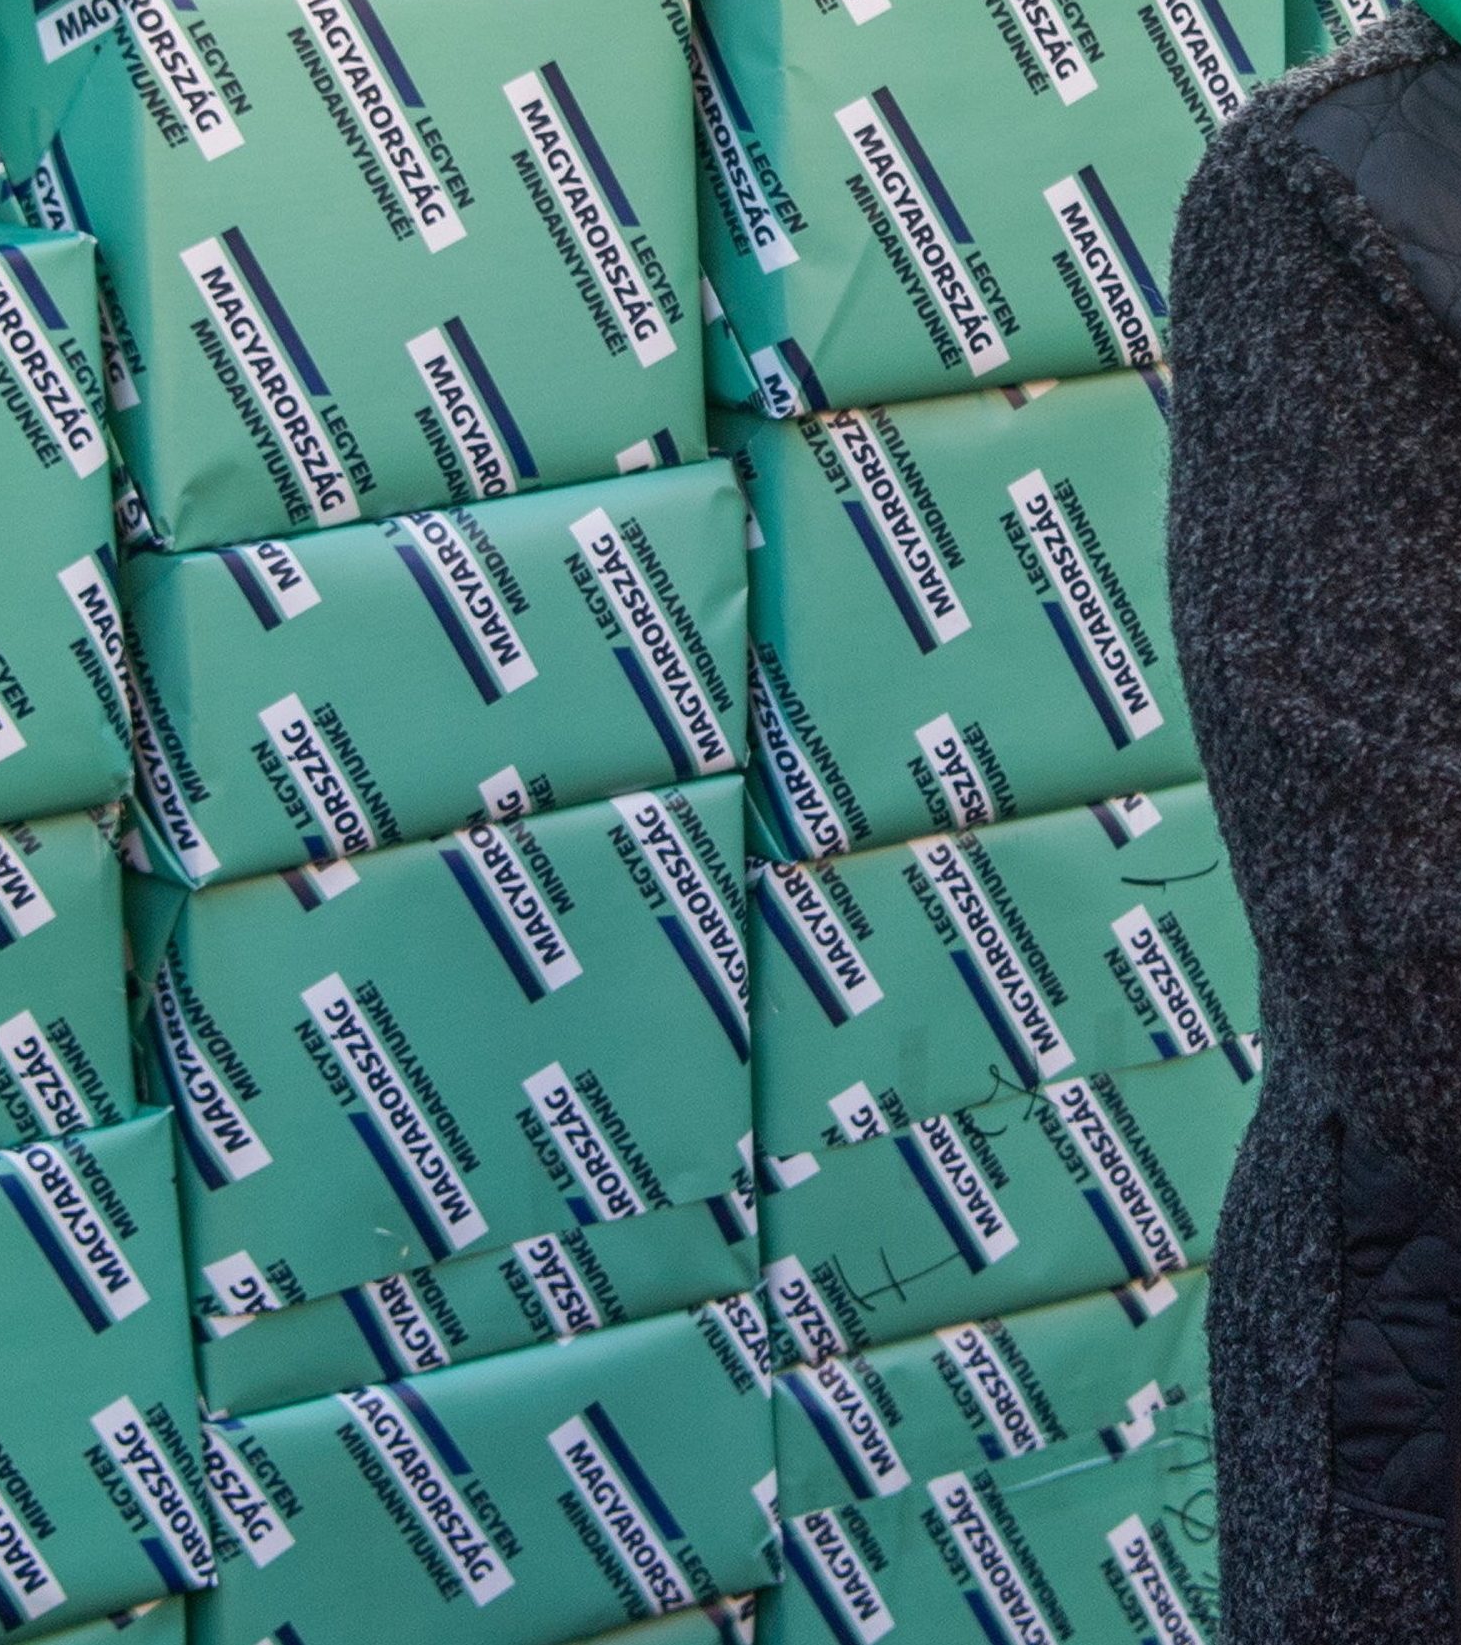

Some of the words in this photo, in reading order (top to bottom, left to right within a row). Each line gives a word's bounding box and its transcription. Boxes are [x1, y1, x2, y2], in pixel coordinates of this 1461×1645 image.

[188, 21, 251, 115] LEGYEN
[287, 27, 415, 241] MINDANNYIUNKÉ!
[415, 116, 473, 209] LEGYEN
[747, 141, 809, 234] LEGYEN
[511, 151, 628, 356] MINDANNYIUNKÉ!
[520, 98, 657, 341] MAGYARORSZÁG
[630, 236, 683, 324] LEGYEN
[845, 174, 961, 371] MINDANNYIUNKÉ!
[853, 122, 993, 356] MAGYARORSZÁG
[1061, 201, 1157, 366] MAGYARORS
[966, 252, 1020, 336] LEGYEN
[191, 318, 311, 526] MINDANNYIUNKÉ!
[201, 266, 345, 511] MAGYARORSZÁG
[321, 405, 375, 493] LEGYEN
[835, 412, 954, 617] MAGYARORSZÁ
[999, 511, 1052, 596] LEGYEN
[1055, 478, 1159, 667] MINDANNYIUNKÉ!
[564, 553, 621, 639] LEGYEN
[592, 533, 729, 762] MAGYARORSZÁG
[621, 517, 735, 712] MINDANNYIUNKÉ!
[1026, 494, 1148, 714] MAGYARORSZÁG
[252, 740, 313, 831] LEGYEN
[759, 643, 872, 842] MINDANNYIUNKÉ!
[608, 823, 666, 910] LEGYEN
[903, 865, 956, 945] LEGYEN
[956, 833, 1068, 1006] MINDANNYIUNKÉ
[928, 844, 1059, 1055] MAGYARORSZÁG
[1103, 947, 1155, 1026] LEGYEN
[293, 1019, 355, 1107] LEGYEN
[324, 999, 473, 1225] MAGYARORSZÁG
[356, 978, 482, 1175] MINDANNYIUNKÉ!
[515, 1108, 576, 1193] LEGYEN
[1033, 1106, 1089, 1184] LEGYEN
[1090, 1073, 1198, 1242] MINDANNYIUNKÉ!
[932, 1353, 985, 1429] LEGYEN
[83, 1445, 150, 1532] LEGYEN
[238, 1435, 304, 1520] LEGYEN
[337, 1423, 462, 1604] MINDANNYIUNKÉ!
[462, 1480, 524, 1560] LEGYEN
[920, 1509, 972, 1587] LEGYEN
[977, 1469, 1075, 1639] MINDANNYIUNKÉ!
[1101, 1558, 1149, 1633] LEGYEN
